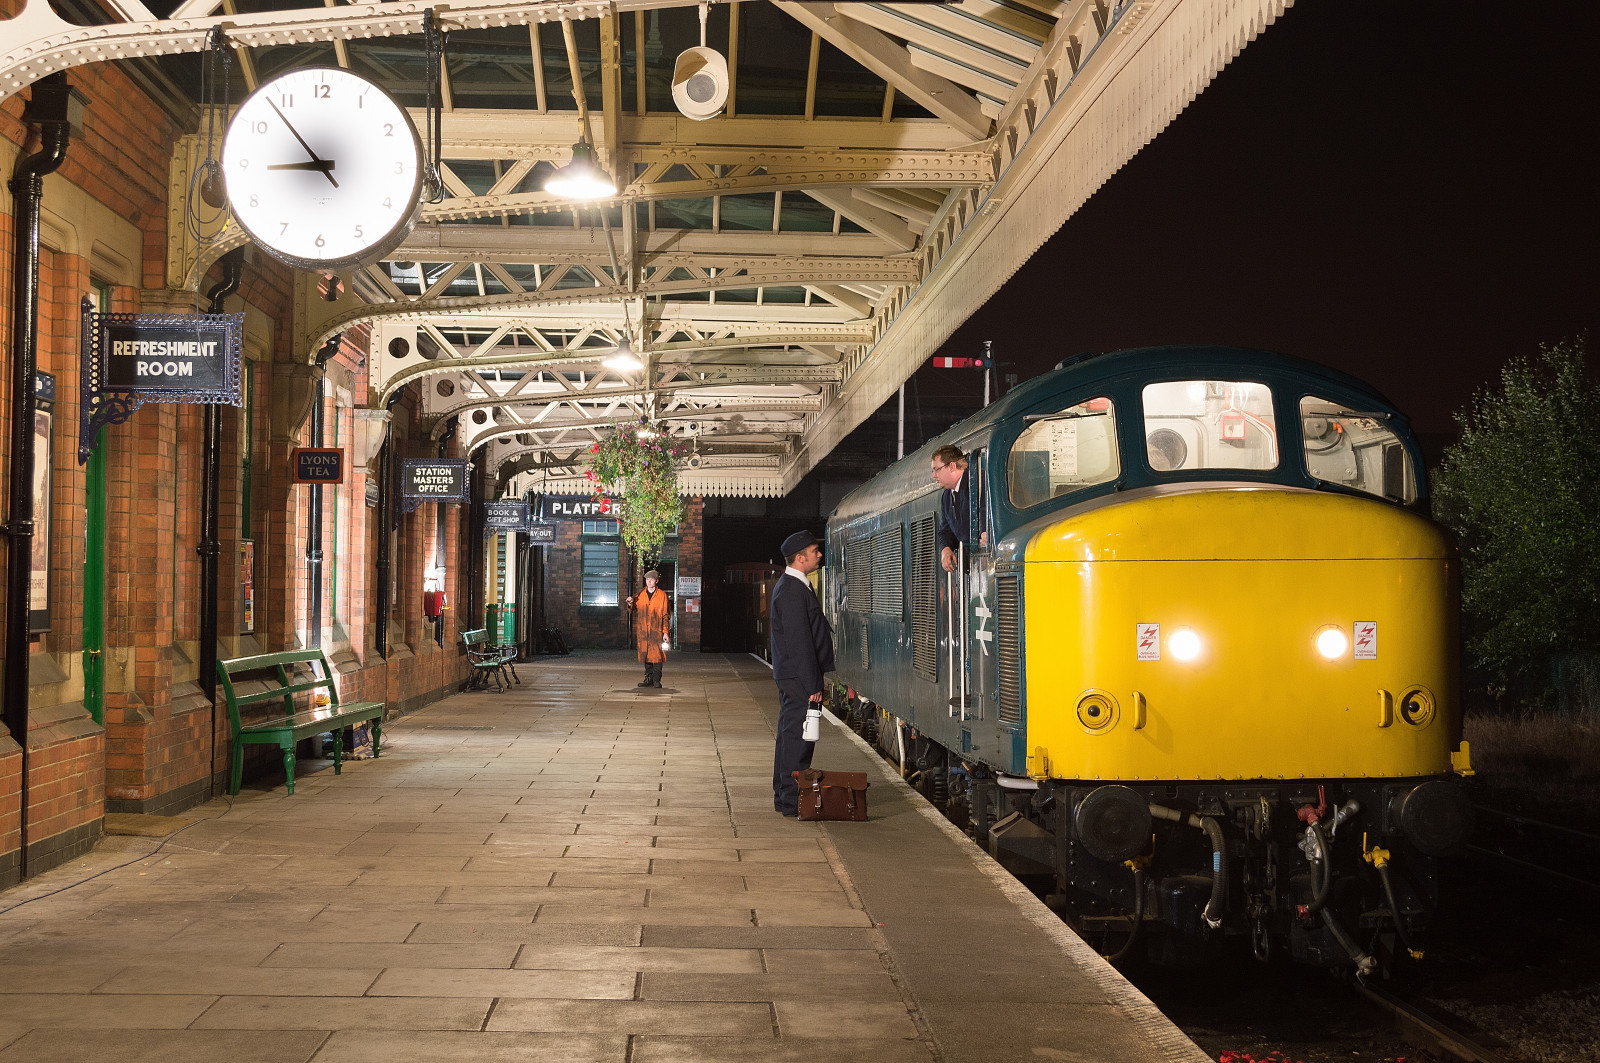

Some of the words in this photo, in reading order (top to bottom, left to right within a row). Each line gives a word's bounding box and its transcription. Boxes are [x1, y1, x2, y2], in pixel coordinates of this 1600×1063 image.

[314, 84, 331, 99] 12
[281, 93, 294, 108] 11
[251, 120, 268, 135] 10
[383, 123, 394, 137] 2
[239, 158, 249, 172] 9
[394, 161, 404, 175] 3
[249, 193, 259, 208] 8
[382, 196, 393, 209] 4
[279, 222, 289, 236] 7
[354, 224, 364, 239] 5
[314, 234, 326, 248] 6
[113, 340, 218, 357] REFRESHMENT
[137, 361, 193, 377] ROOM
[300, 455, 338, 465] LYONS
[307, 467, 330, 476] TEA
[415, 467, 452, 476] STATION
[413, 476, 454, 484] MASTERS
[418, 484, 449, 493] OFFICE
[552, 502, 627, 515] PLATFR
